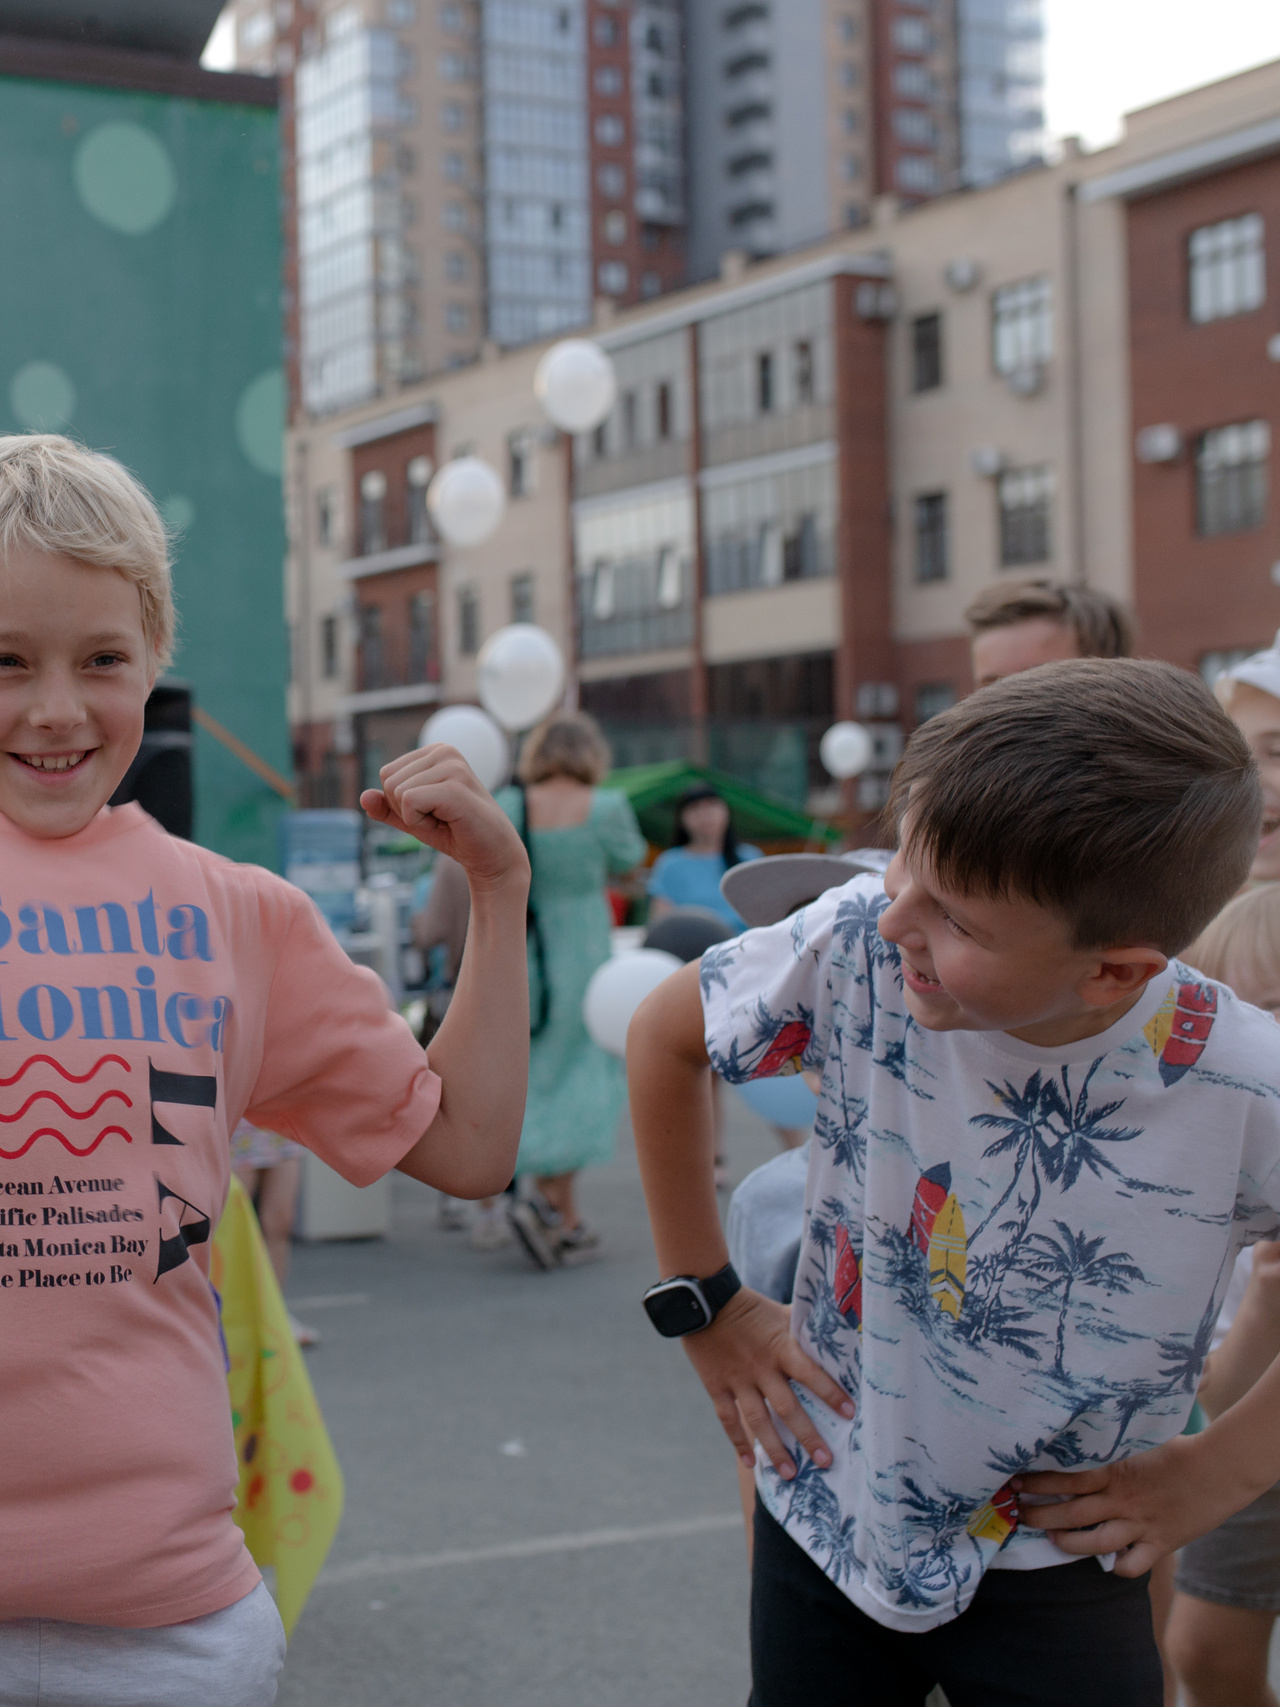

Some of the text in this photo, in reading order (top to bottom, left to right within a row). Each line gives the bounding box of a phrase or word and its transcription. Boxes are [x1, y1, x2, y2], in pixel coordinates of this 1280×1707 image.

[49, 1175, 125, 1195] Avenue
[41, 1204, 145, 1226] Palisades
[22, 1237, 106, 1257] Monica
[109, 1235, 150, 1257] Bay
[18, 1268, 81, 1288] Place
[84, 1269, 106, 1285] to
[109, 1264, 133, 1284] Be
